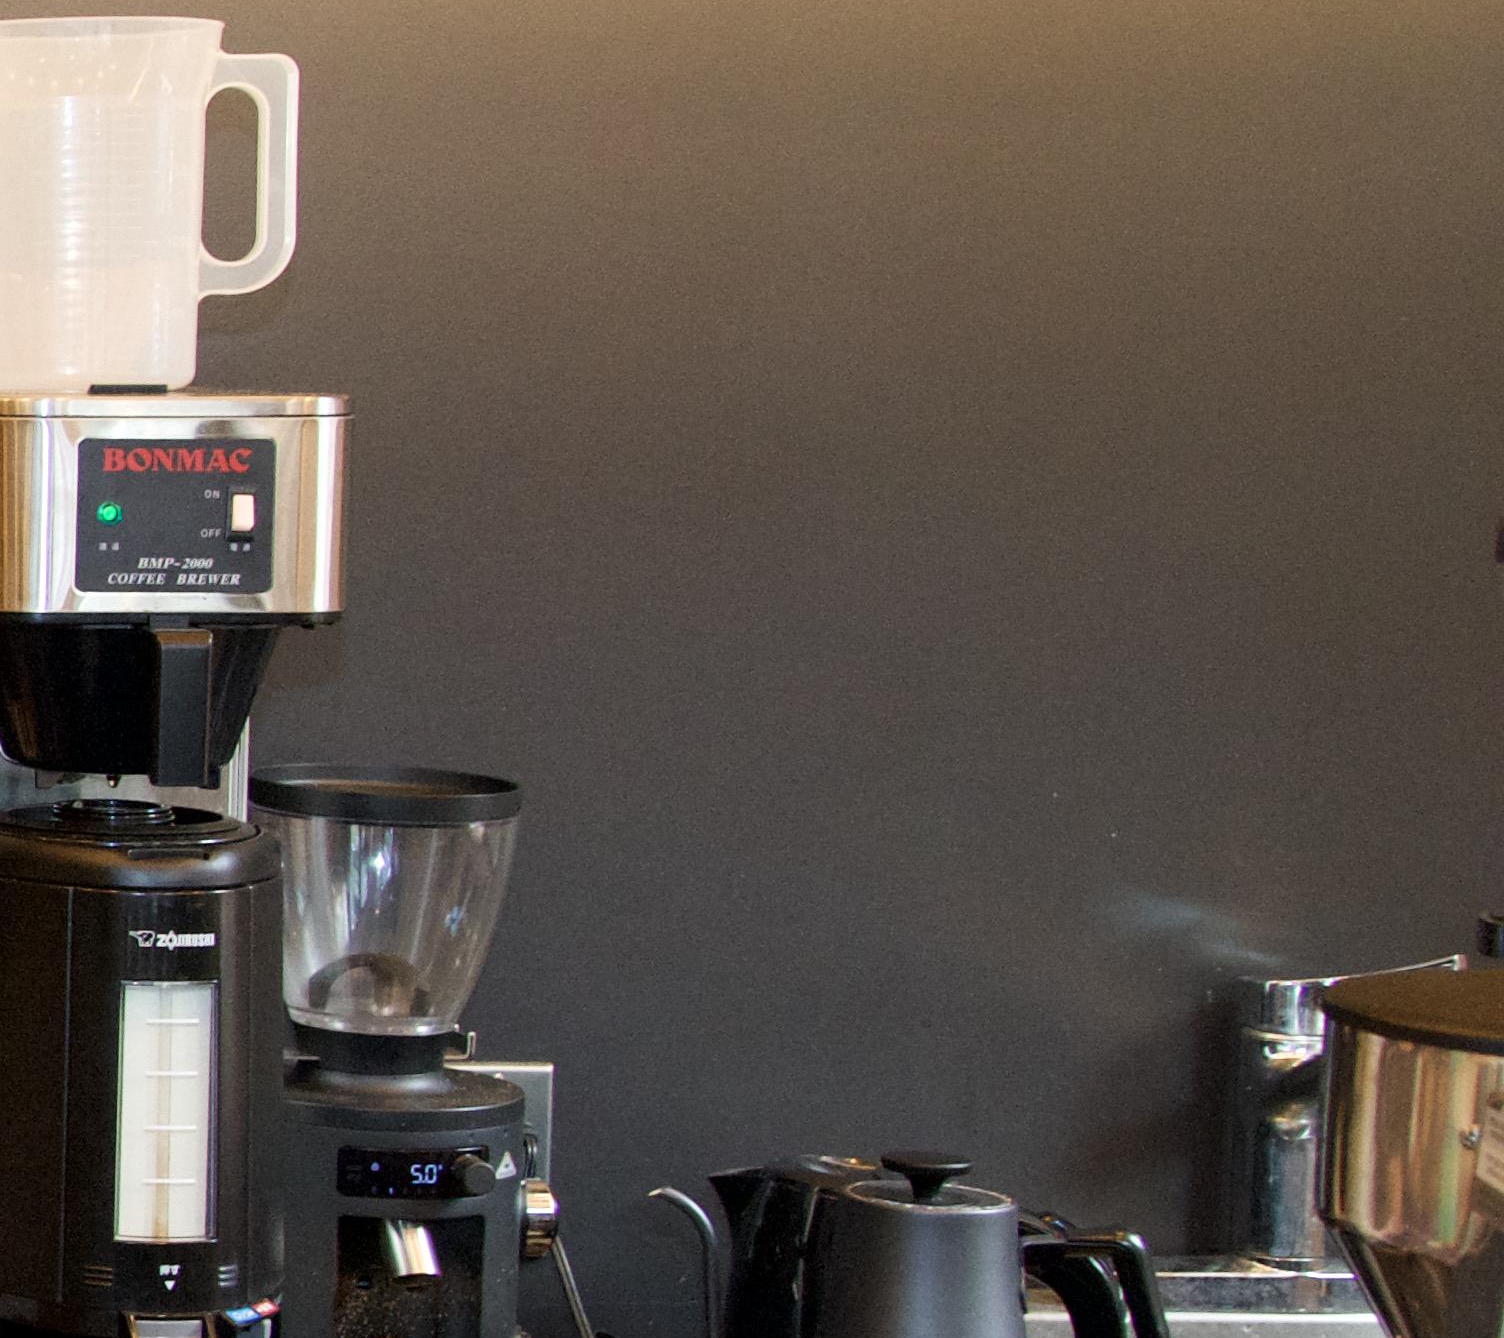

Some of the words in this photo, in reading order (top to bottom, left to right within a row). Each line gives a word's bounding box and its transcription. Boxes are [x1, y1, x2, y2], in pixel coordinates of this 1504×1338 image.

[102, 447, 253, 473] BONMAC
[204, 489, 220, 499] ON
[200, 528, 222, 538] OFF
[138, 557, 214, 570] BMP-2000
[107, 572, 166, 585] COFFEE
[176, 573, 241, 586] BREWER
